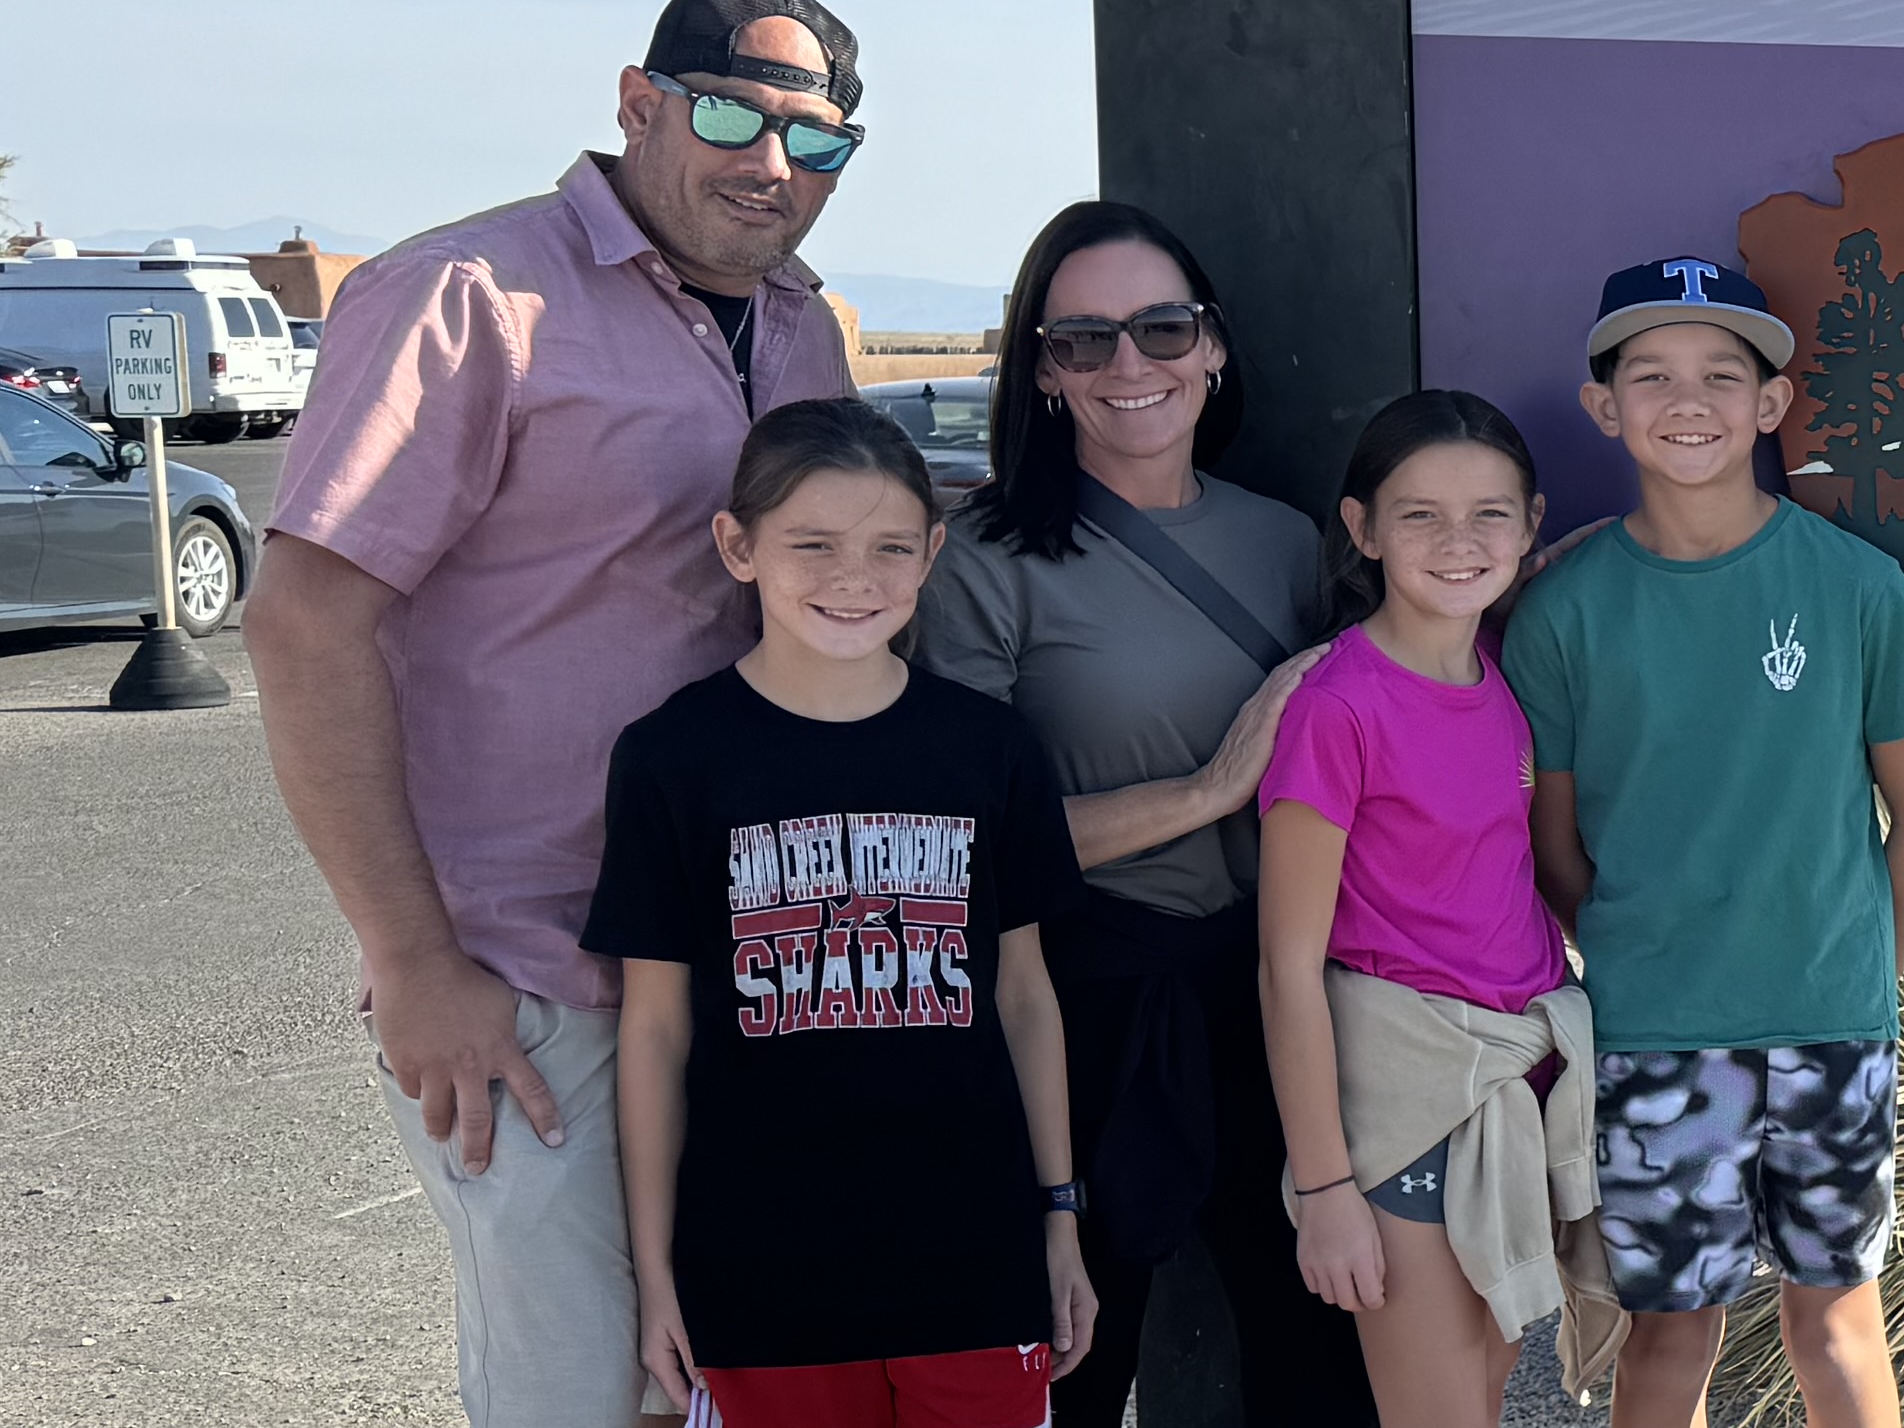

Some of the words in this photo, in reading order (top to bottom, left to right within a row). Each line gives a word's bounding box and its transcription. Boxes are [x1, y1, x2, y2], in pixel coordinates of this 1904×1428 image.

[1663, 259, 1719, 303] T
[130, 329, 152, 349] RV
[114, 357, 172, 375] PARKING
[128, 383, 162, 400] ONLY
[779, 813, 848, 902] CREEK
[733, 926, 974, 1037] SHARKS
